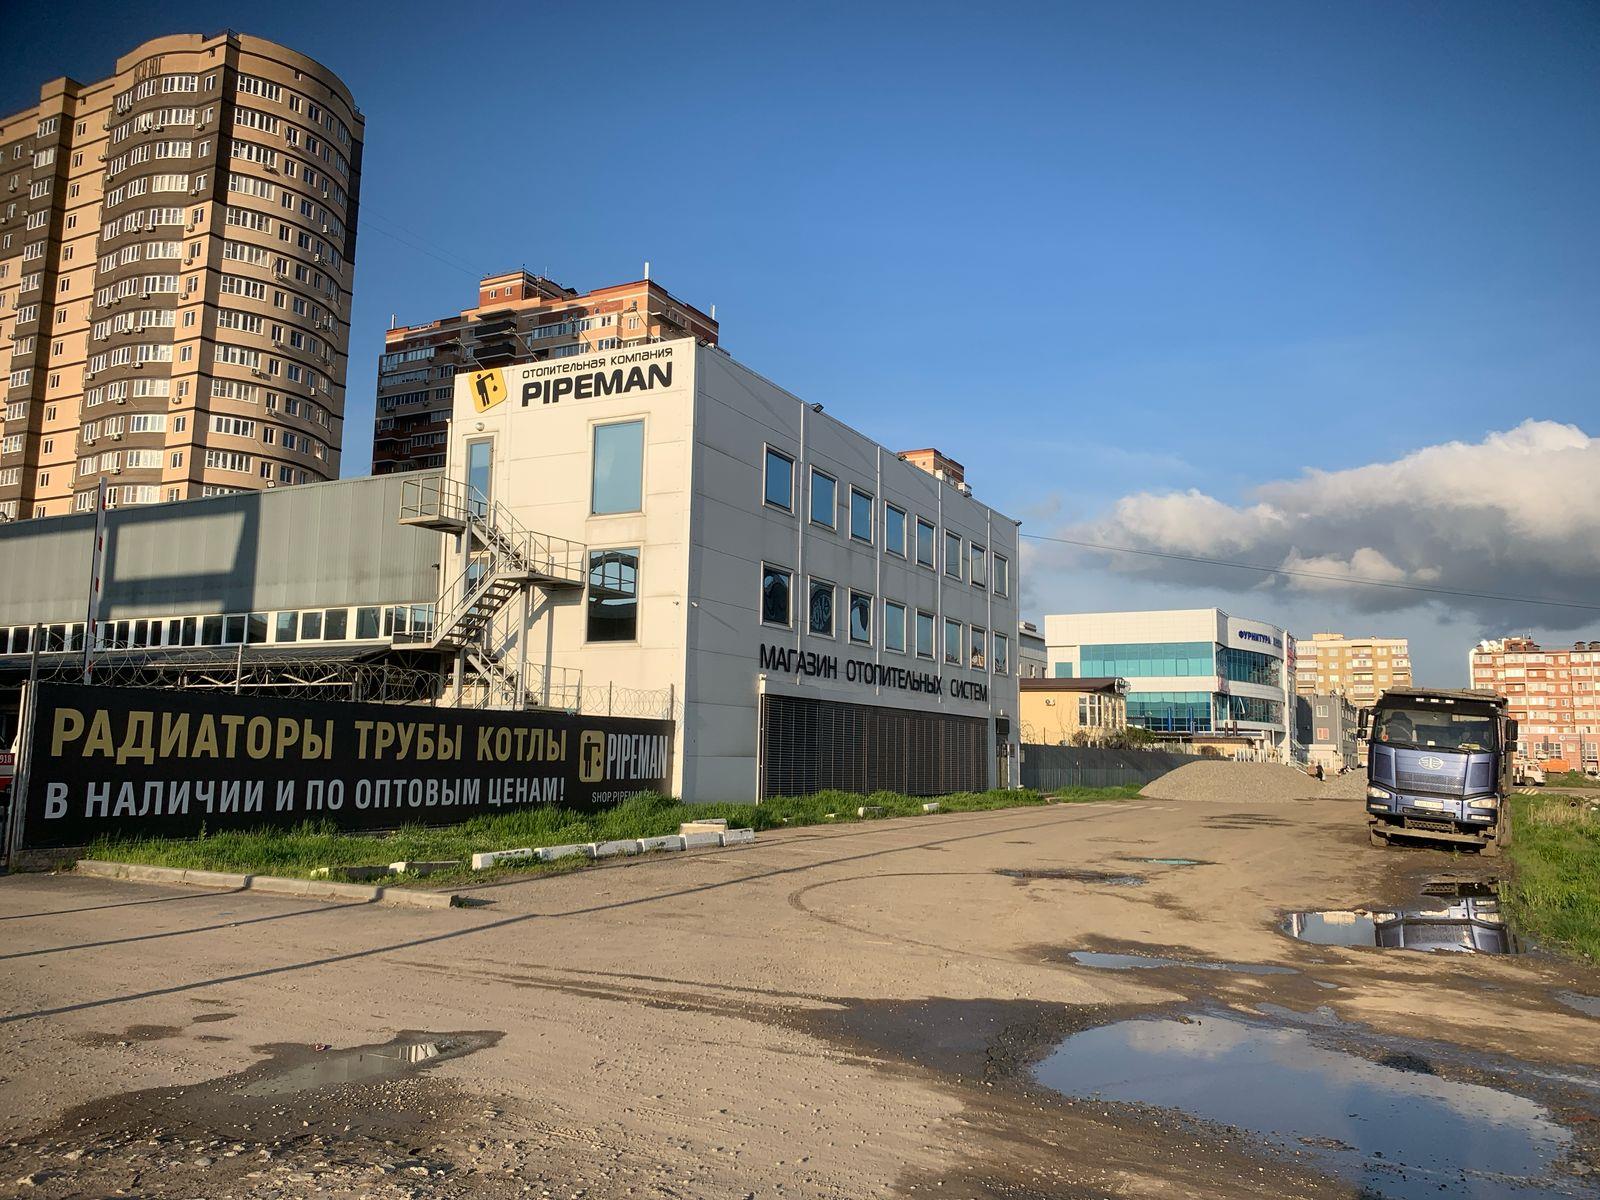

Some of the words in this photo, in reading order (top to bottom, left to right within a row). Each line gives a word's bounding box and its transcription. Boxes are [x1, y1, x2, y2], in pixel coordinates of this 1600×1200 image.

[522, 361, 673, 407] PIPEMAN
[759, 643, 837, 680] МАГАЗИН
[846, 659, 943, 695] ОТОПИТЕЛЬНЫХ
[950, 678, 988, 703] СИСТЕМ
[51, 706, 334, 766] РАДИАТОРЫ
[355, 720, 463, 762] ТРУБЫ
[477, 726, 567, 763] КОТЛЫ
[606, 733, 669, 780] PIPEMAN
[45, 781, 69, 819] В
[86, 778, 263, 818] НАЛИЧИИ
[276, 778, 294, 812] И
[306, 778, 344, 811] ПО
[355, 776, 480, 810] ОПТОВЫМ
[488, 776, 565, 808] ЦЕНАМ!
